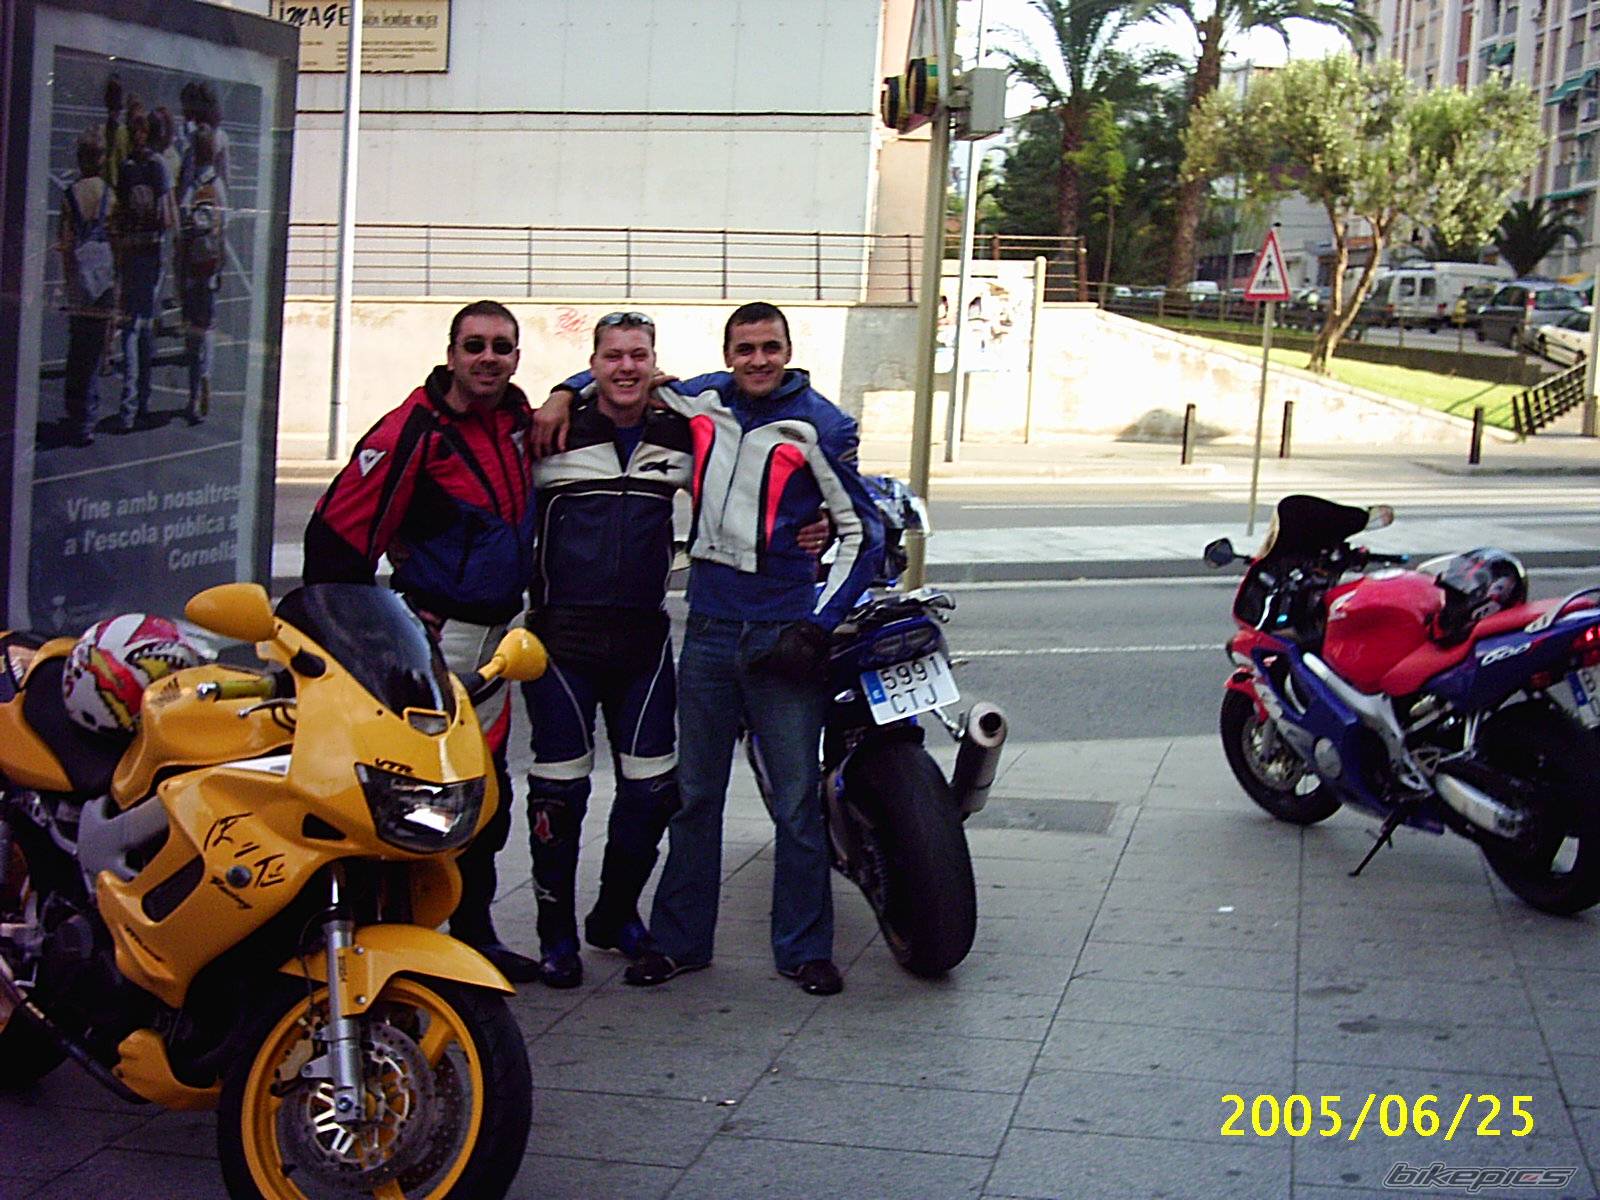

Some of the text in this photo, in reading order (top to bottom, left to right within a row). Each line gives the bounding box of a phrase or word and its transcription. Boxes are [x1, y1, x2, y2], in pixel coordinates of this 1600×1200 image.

[67, 484, 240, 522] Vine amb nosaltres
[64, 538, 77, 555] a
[83, 523, 157, 553] l'escola
[163, 514, 225, 546] pública
[881, 656, 940, 690] 5991
[891, 684, 937, 713] CTJ
